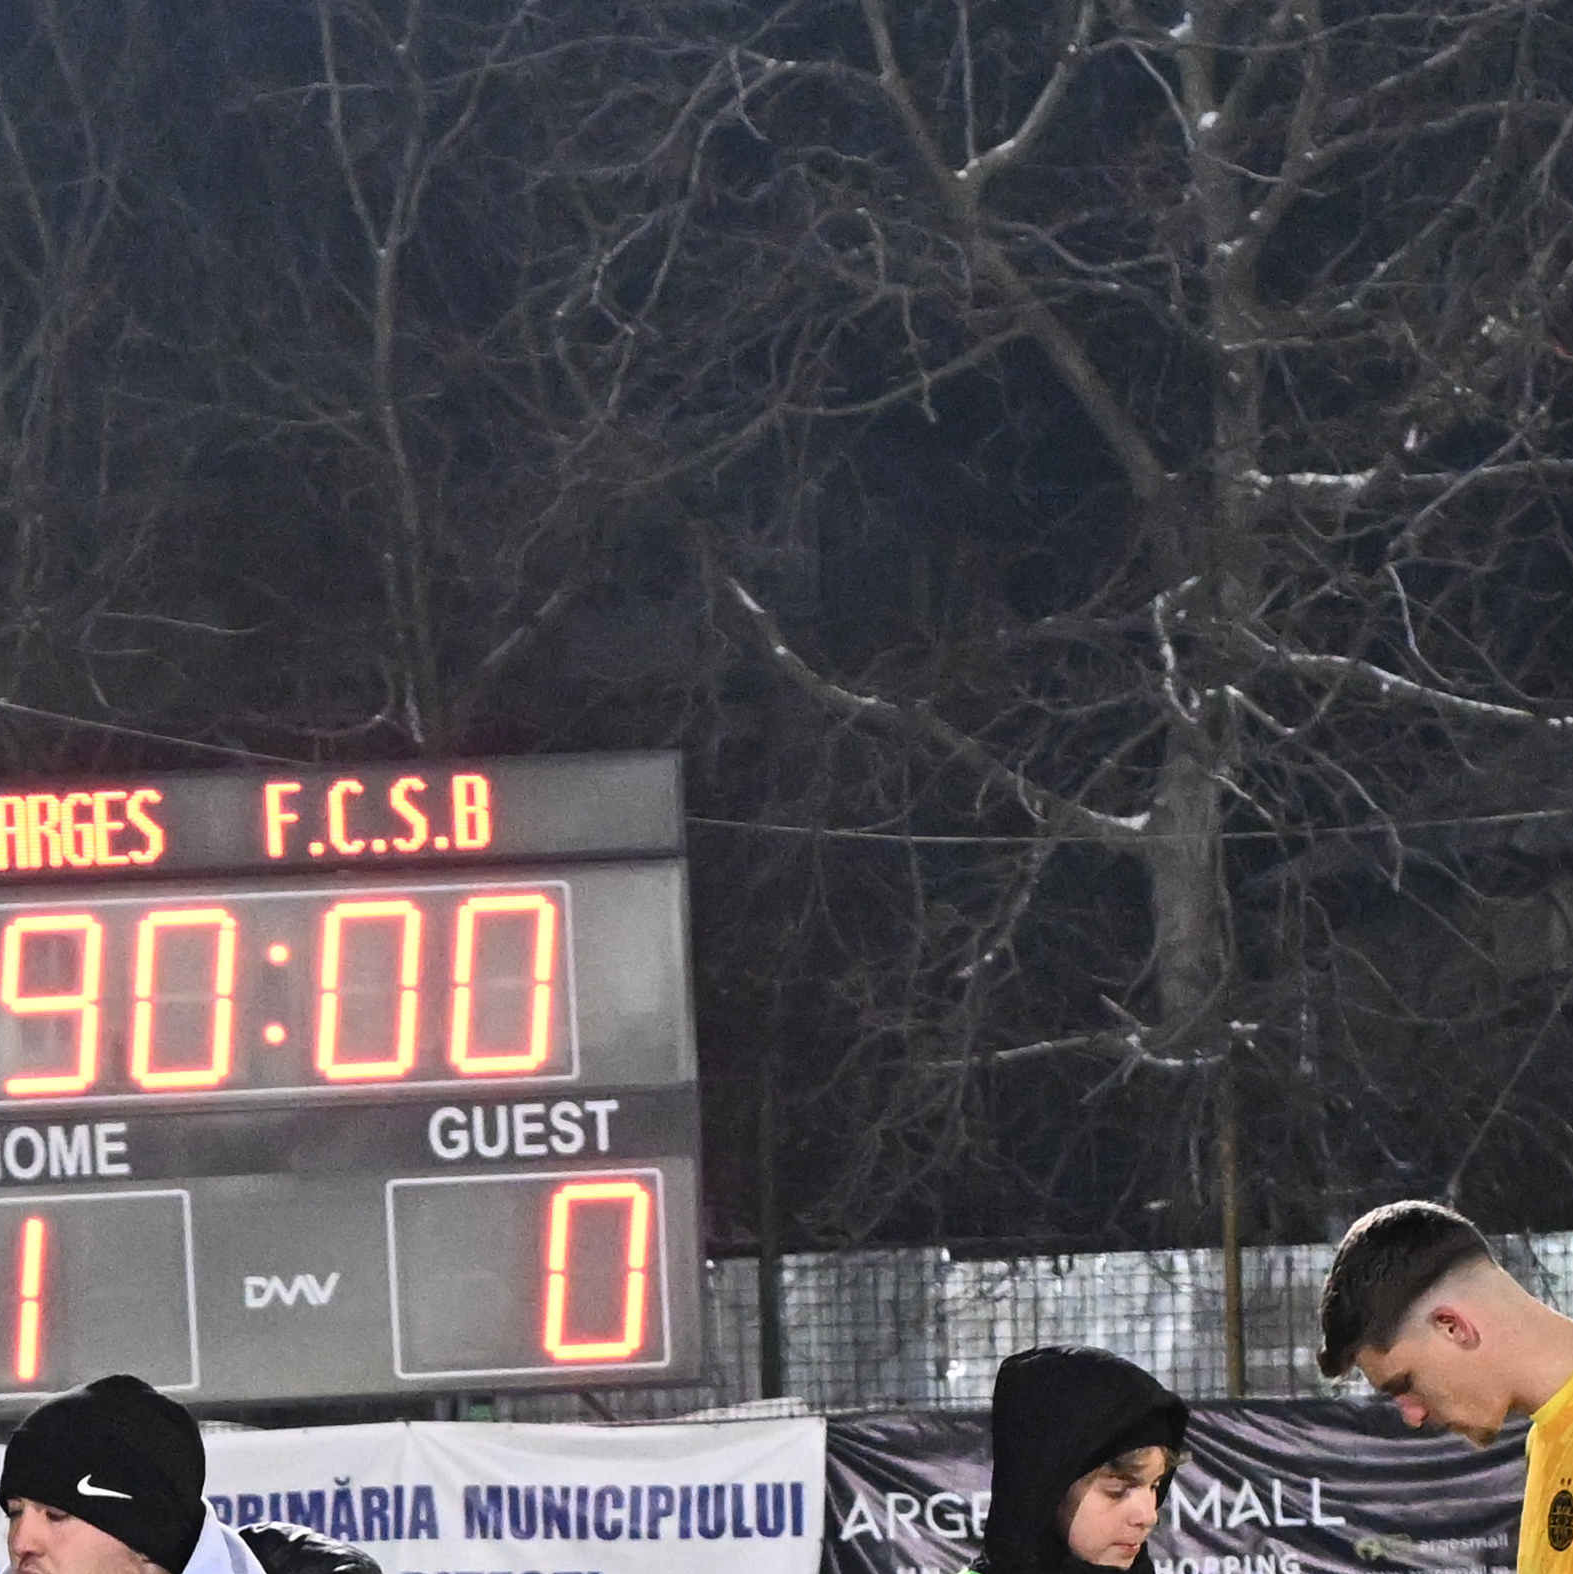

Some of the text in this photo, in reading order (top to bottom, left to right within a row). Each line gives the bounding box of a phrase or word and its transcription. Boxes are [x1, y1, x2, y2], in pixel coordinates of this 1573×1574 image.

[263, 774, 493, 859] F.C.S.B
[0, 893, 556, 1094] 90:00
[428, 1098, 622, 1160] GUEST
[15, 1180, 652, 1382] 1 0
[209, 1476, 806, 1542] PRIMĂRIA MUNICIPIULUI
[839, 1476, 1348, 1542] ARGE MALL
